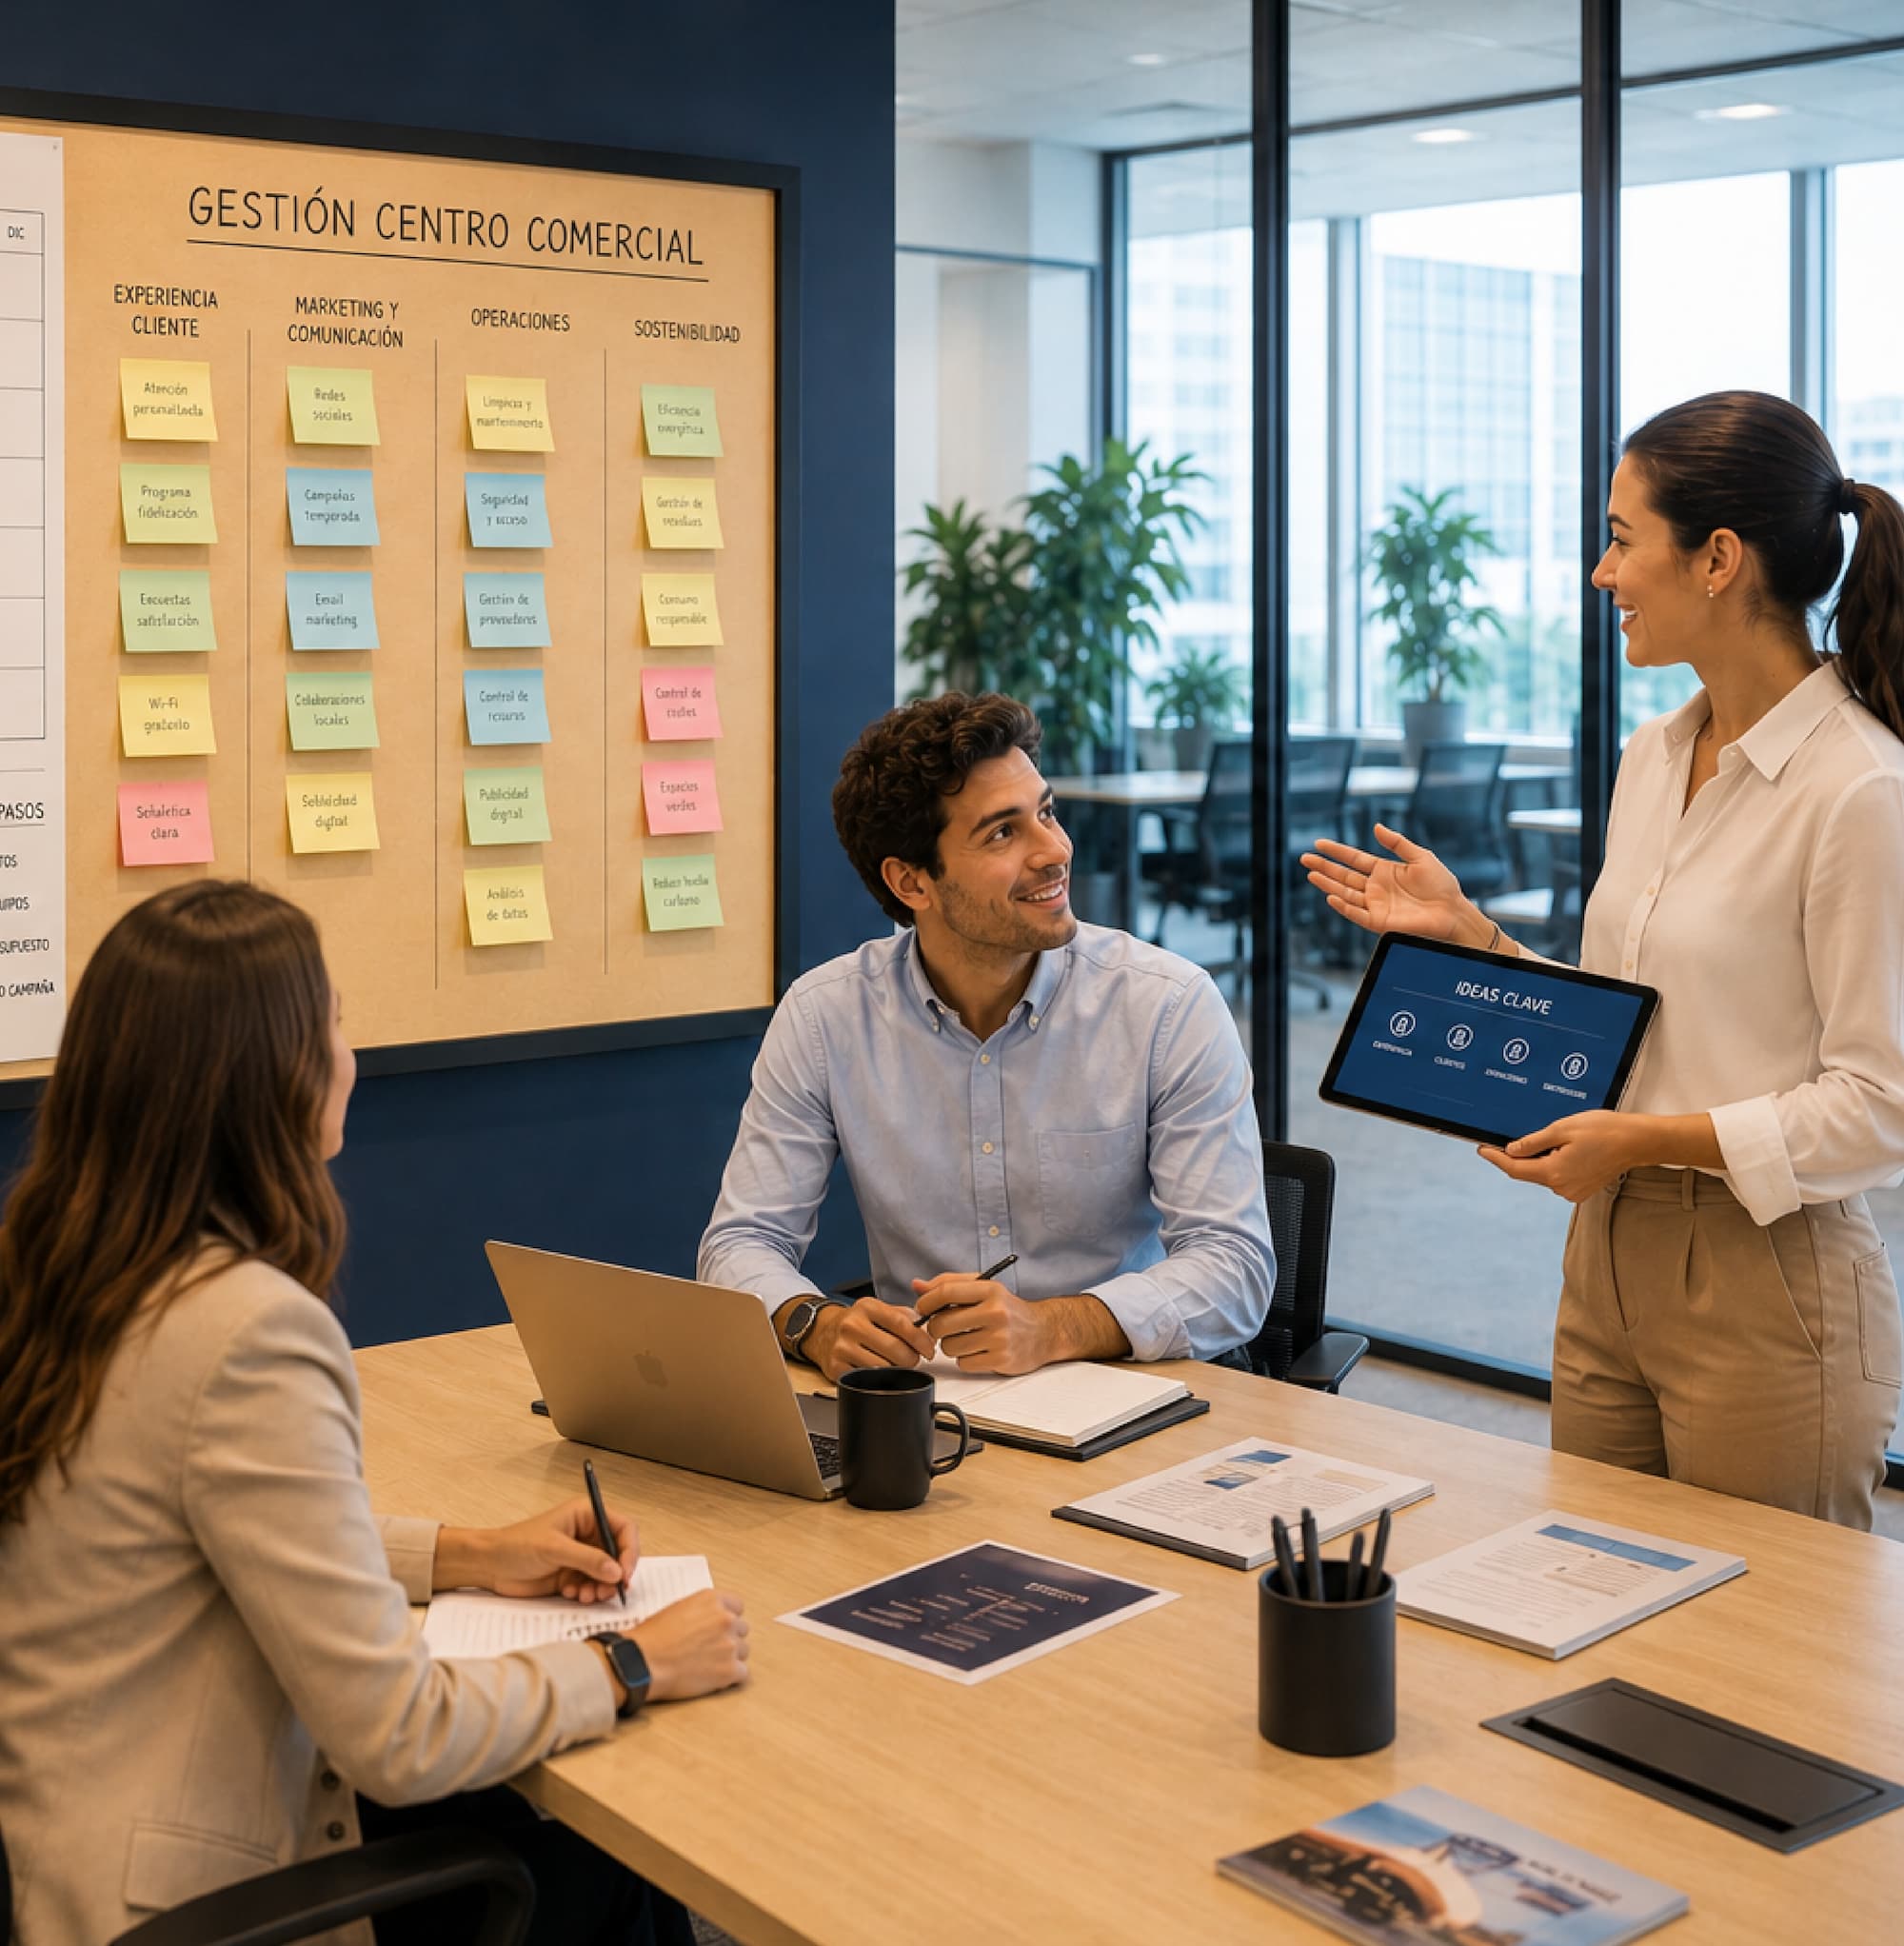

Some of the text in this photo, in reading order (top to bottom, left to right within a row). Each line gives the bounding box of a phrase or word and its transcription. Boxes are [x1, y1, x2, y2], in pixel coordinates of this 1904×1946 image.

[189, 186, 703, 265] GESTIÓN CENTRO COMERCIAL
[114, 284, 218, 308] EXPERIENCIA
[296, 297, 399, 320] MARKETING Y
[471, 308, 570, 331] OPERACIONES
[132, 316, 199, 337] CLIENTE
[288, 324, 403, 348] COMUNICACIÓN
[635, 320, 740, 343] SOSTENIBILIDAD
[141, 485, 190, 501] Programa
[316, 593, 343, 606] Email
[0, 803, 44, 820] PASOS
[151, 827, 179, 840] clara
[1503, 992, 1553, 1015] CLAVE
